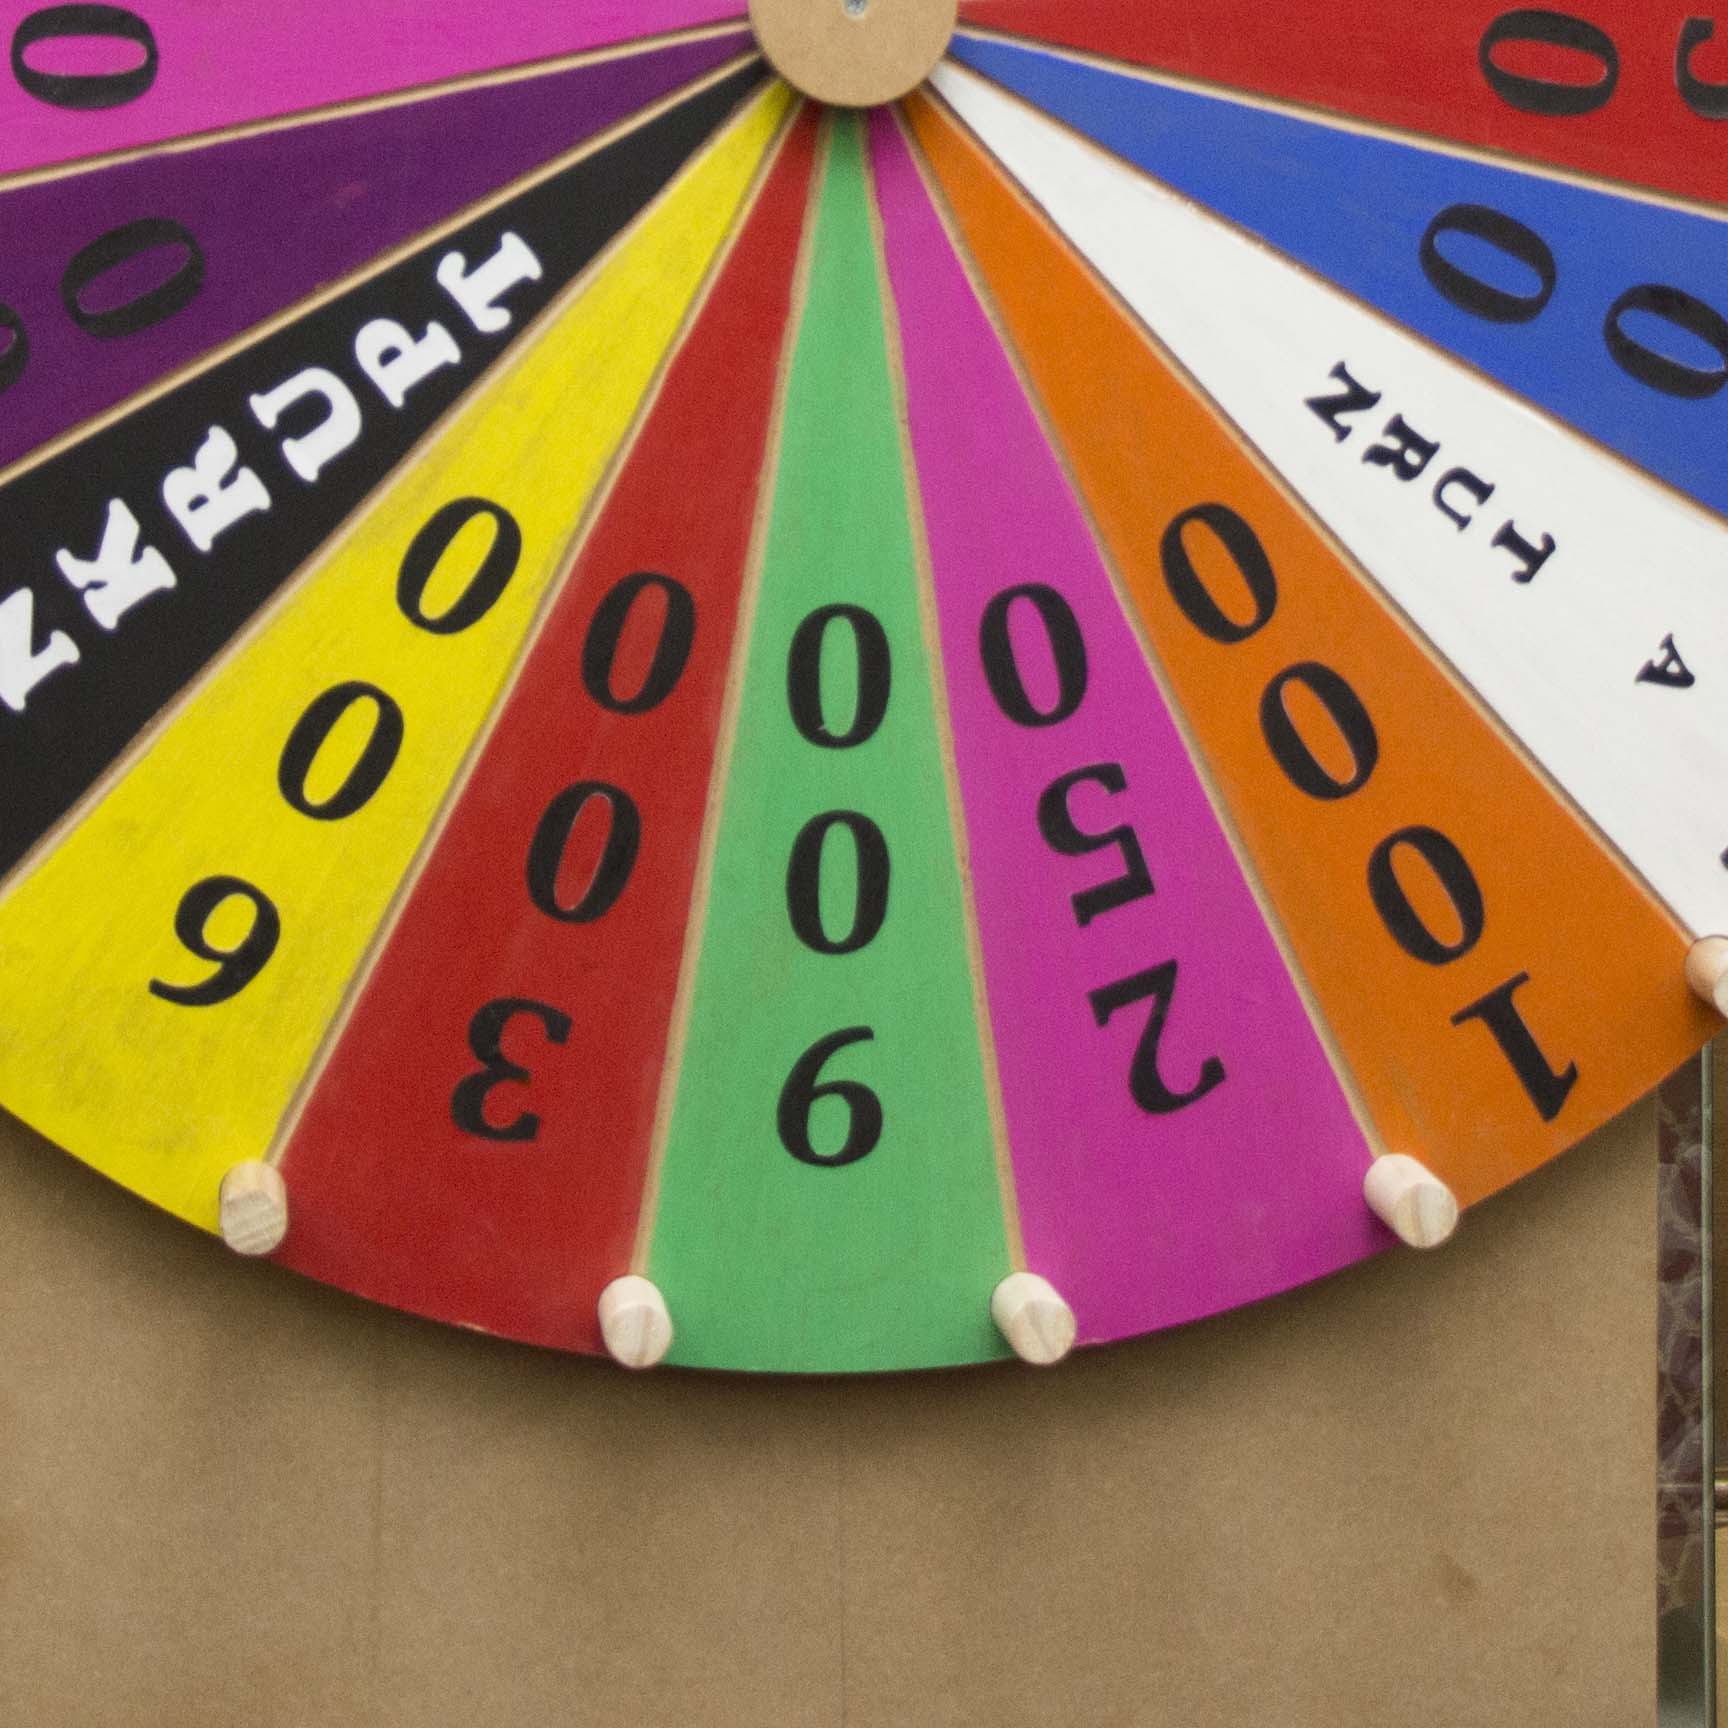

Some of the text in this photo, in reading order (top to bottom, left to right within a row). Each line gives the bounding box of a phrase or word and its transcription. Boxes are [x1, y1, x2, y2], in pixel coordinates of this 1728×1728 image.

[1303, 360, 1557, 584] TURN
[1634, 633, 1695, 692] A
[450, 571, 697, 1144] 300
[978, 582, 1226, 1115] 250
[1158, 501, 1578, 1123] 1000
